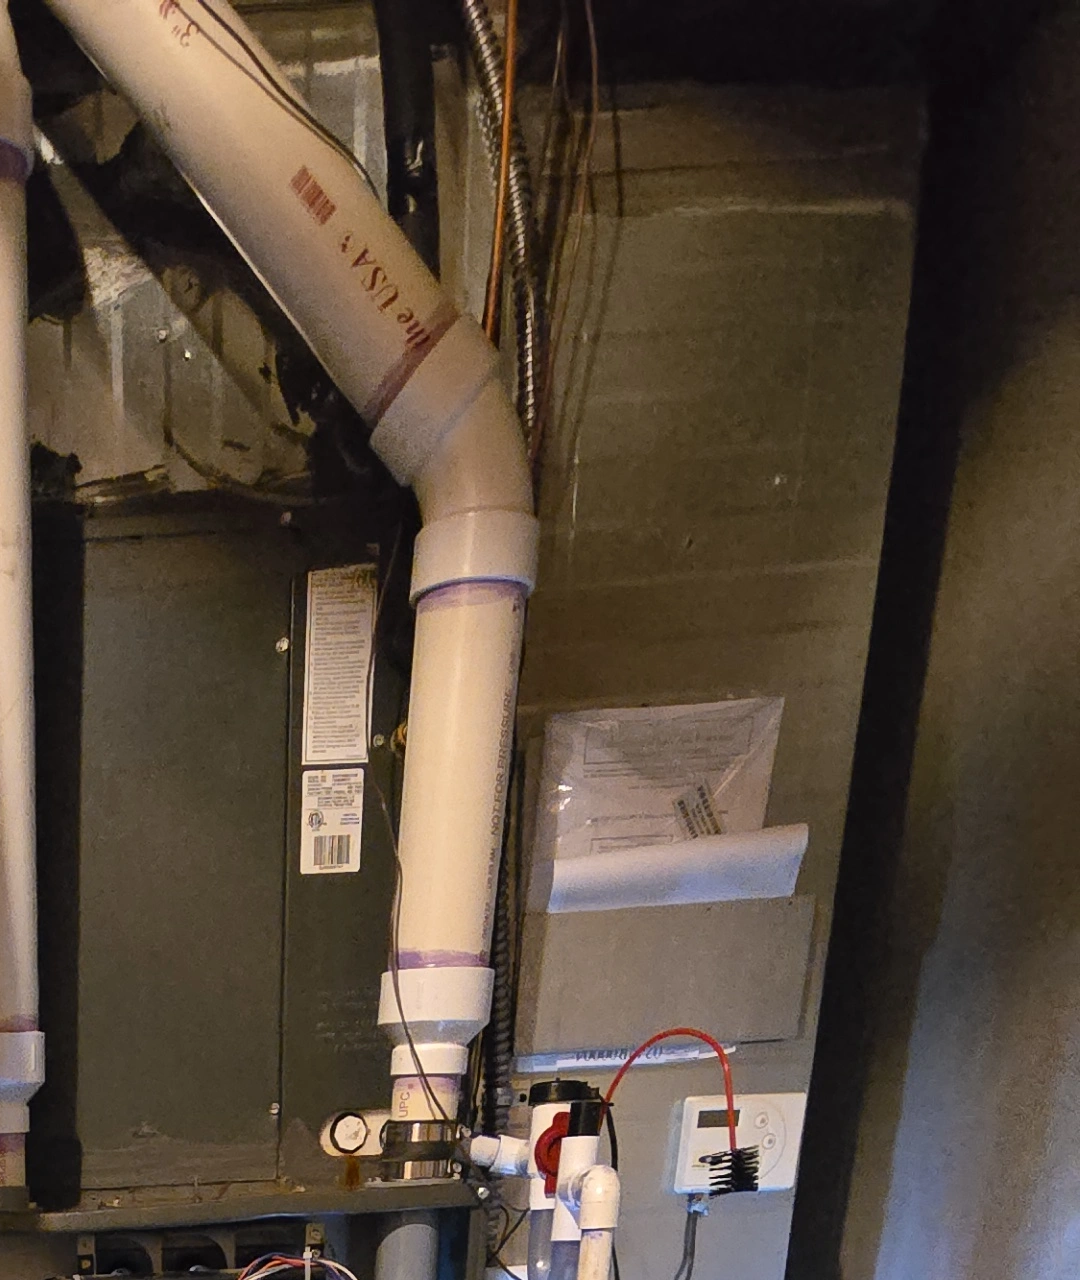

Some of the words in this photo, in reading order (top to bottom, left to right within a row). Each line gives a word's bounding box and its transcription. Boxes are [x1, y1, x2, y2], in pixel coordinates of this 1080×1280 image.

[350, 246, 400, 314] USA
[397, 306, 432, 349] the
[497, 687, 513, 770] PRESSURE
[398, 1091, 411, 1118] UPC
